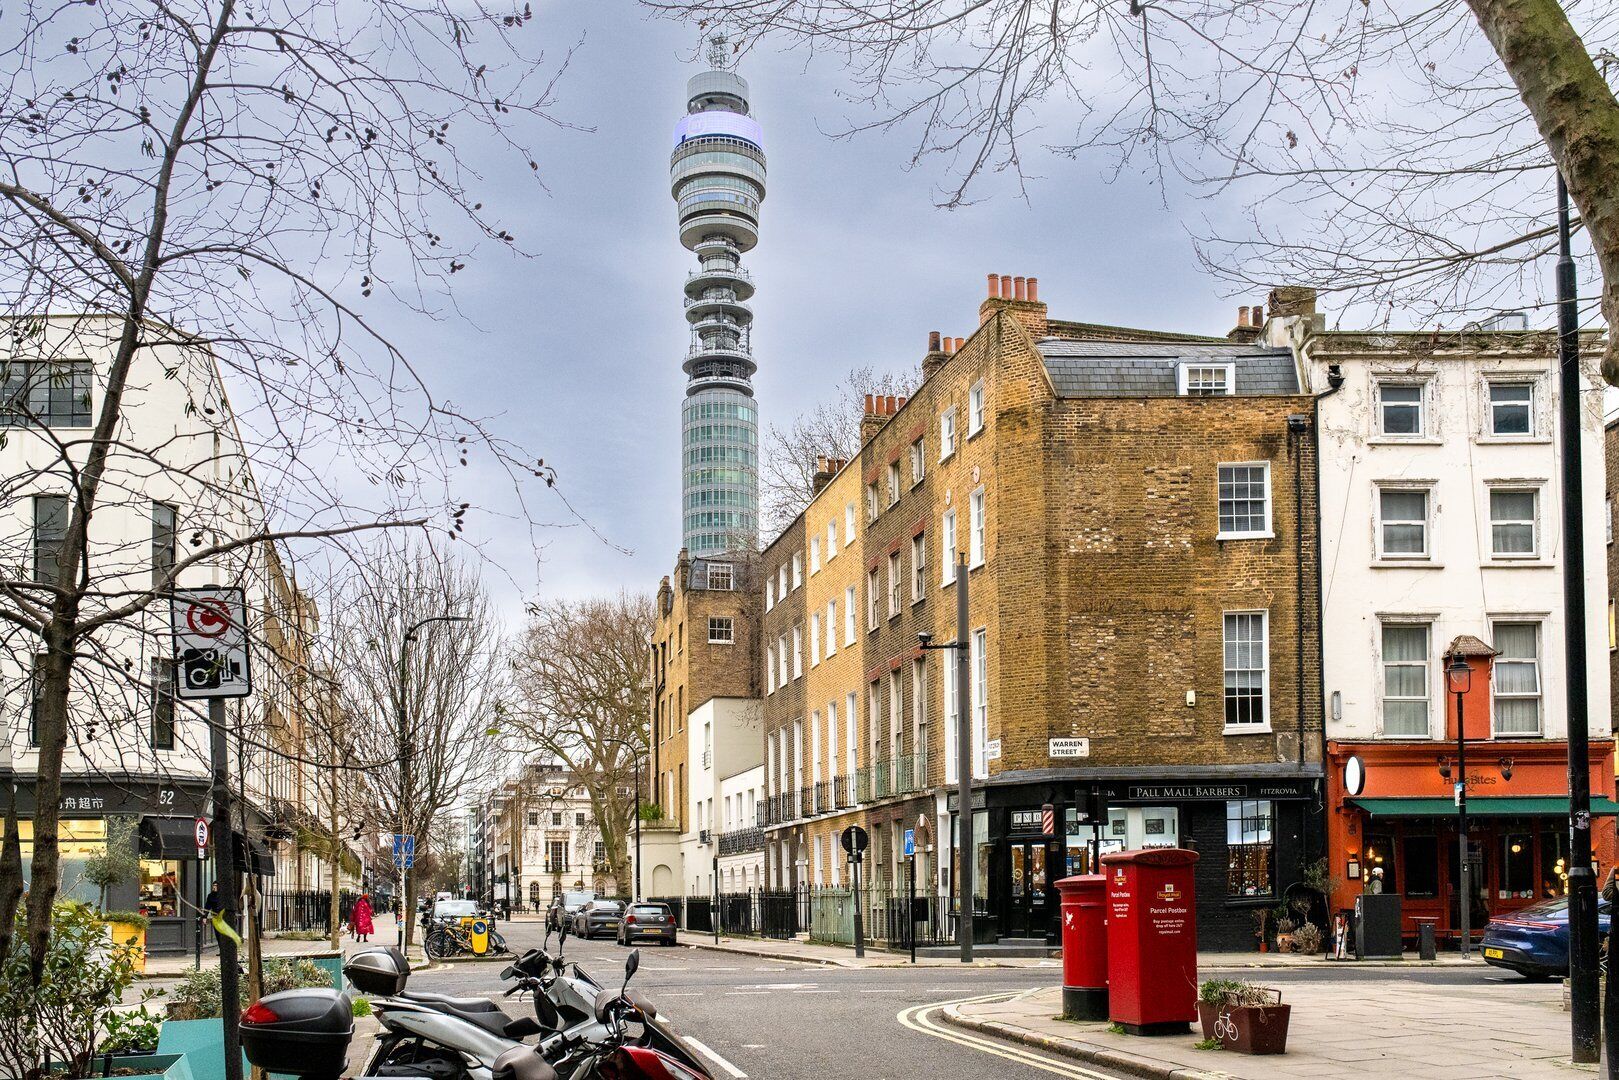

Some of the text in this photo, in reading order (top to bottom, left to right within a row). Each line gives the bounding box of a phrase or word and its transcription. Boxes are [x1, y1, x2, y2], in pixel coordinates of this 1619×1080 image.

[1052, 748, 1077, 756] STREET
[160, 790, 174, 805] 52
[1136, 787, 1240, 797] PALL MALL BARBERS
[59, 796, 104, 809] 舟超市
